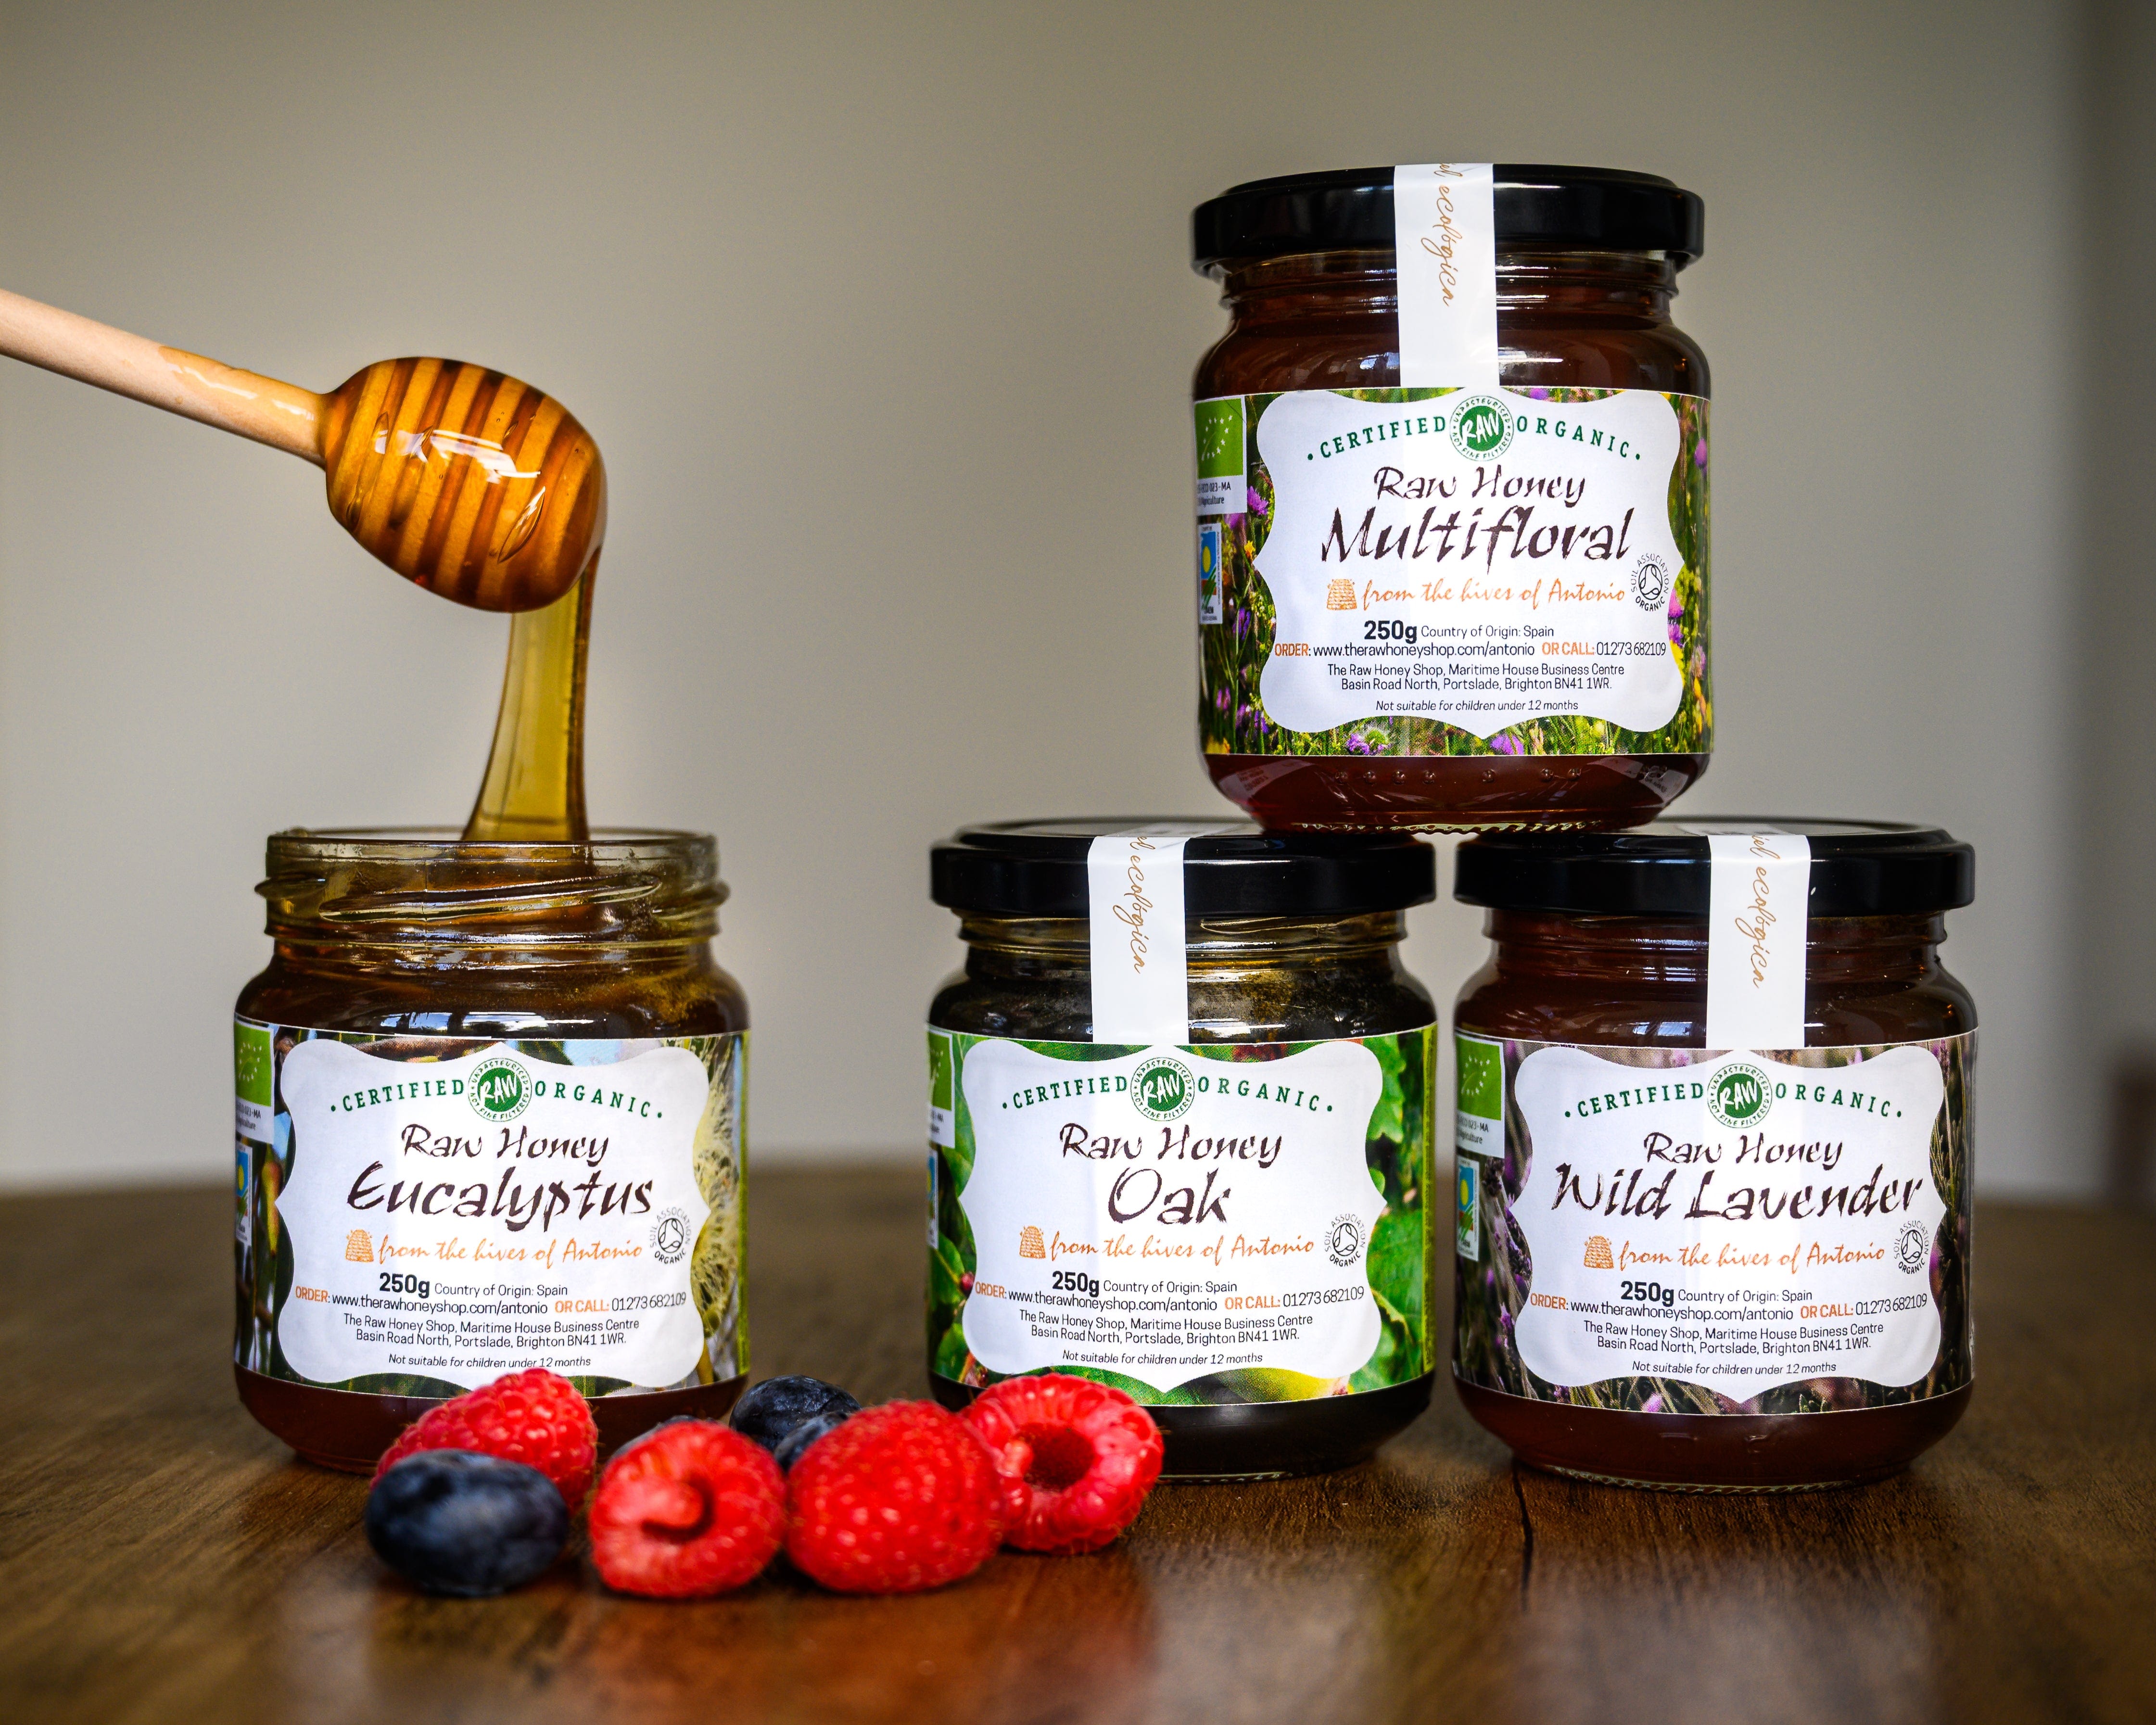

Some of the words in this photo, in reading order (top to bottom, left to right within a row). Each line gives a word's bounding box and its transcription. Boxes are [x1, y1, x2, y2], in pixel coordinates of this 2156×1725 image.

[1320, 416, 1446, 458] CERTIFIED
[1517, 416, 1629, 457] ORGANIC
[1461, 411, 1499, 446] RAW
[1374, 467, 1456, 500] Raw
[1472, 464, 1585, 508] Honey
[1321, 505, 1635, 575] Multifloral
[1637, 553, 1669, 594] ASSOCIATION
[1363, 580, 1415, 611] from
[1422, 578, 1452, 602] the
[1460, 578, 1511, 602] hives
[1520, 579, 1542, 610] of
[1548, 578, 1624, 602] Antonio
[1636, 596, 1665, 612] ORGANIC
[1364, 620, 1417, 644] 250g
[1421, 626, 1466, 640] Country
[1471, 625, 1483, 637] of
[1486, 625, 1520, 639] Origin:
[1524, 625, 1554, 639] Spain
[1275, 643, 1311, 656] ORDER:
[1313, 641, 1535, 659] www.therawhoneyshop.com/antonio
[1328, 663, 1346, 675] The
[1350, 664, 1371, 675] Raw
[1375, 664, 1410, 679] Honey
[1414, 663, 1445, 677] Shop,
[1449, 663, 1499, 675] Maritime
[1503, 663, 1538, 675] House
[1542, 663, 1589, 675] Business
[1592, 663, 1624, 675] Centre
[1342, 678, 1370, 690] Basin
[1373, 678, 1401, 690] Road
[1405, 678, 1440, 691] North,
[1444, 678, 1501, 690] Portslade,
[1505, 677, 1552, 692] Brighton
[1555, 677, 1583, 689] BN41
[1587, 677, 1611, 689] 1WR.
[1376, 700, 1394, 710] Not
[1397, 700, 1436, 710] suitable
[1439, 700, 1453, 710] for
[1456, 700, 1495, 710] children
[1498, 700, 1526, 710] under
[1528, 700, 1541, 710] 12
[1544, 700, 1578, 710] months
[343, 1079, 464, 1112] CERTIFIED
[535, 1080, 650, 1117] ORGANIC
[480, 1073, 517, 1107] RAW
[1013, 1076, 1128, 1108] CERTIFIED
[1198, 1076, 1319, 1111] ORGANIC
[1142, 1073, 1180, 1107] RAW
[1577, 1083, 1703, 1117] CERTIFIED
[1776, 1083, 1890, 1117] ORGANIC
[1719, 1079, 1757, 1114] RAW
[1719, 1114, 1738, 1126] FINE
[401, 1124, 482, 1158] Raw
[497, 1125, 609, 1167] Honey
[1060, 1123, 1141, 1159] Raw
[1158, 1124, 1282, 1168] Honey
[1644, 1132, 1721, 1164] Raw
[1736, 1132, 1842, 1171] Honey
[347, 1161, 653, 1232] Eucalyptus
[1108, 1167, 1231, 1225] Oak
[1551, 1163, 1676, 1220] Wild
[1684, 1164, 1923, 1220] Lavender
[379, 1235, 429, 1264] from
[436, 1237, 466, 1260] the
[473, 1238, 526, 1261] hives
[533, 1239, 556, 1269] of
[563, 1238, 642, 1262] Antonio
[1051, 1231, 1098, 1261] from
[1103, 1234, 1136, 1257] the
[1141, 1235, 1193, 1258] hives
[1202, 1235, 1224, 1266] of
[1231, 1234, 1314, 1259] Antonio
[1900, 1220, 1929, 1255] ASSOCIATION
[1618, 1241, 1673, 1271] from
[1678, 1243, 1709, 1267] the
[1716, 1243, 1770, 1267] hives
[1779, 1243, 1801, 1274] of
[1807, 1242, 1884, 1267] Antonio
[1898, 1258, 1925, 1275] ORGANIC
[296, 1286, 330, 1303] ORDER:
[332, 1294, 547, 1316] www.therawhoneyshop.com/antonio
[380, 1272, 430, 1299] 250g
[435, 1283, 480, 1298] Country
[483, 1284, 495, 1295] of
[498, 1285, 533, 1298] Origin:
[537, 1285, 567, 1298] Spain
[976, 1281, 1006, 1299] ORDER:
[1009, 1291, 1217, 1313] www.therawhoneyshop.com/antonio
[1053, 1271, 1099, 1298] 250g
[1103, 1281, 1149, 1294] Country
[1152, 1281, 1164, 1292] of
[1167, 1281, 1202, 1295] Origin:
[1205, 1281, 1237, 1294] Spain
[1621, 1281, 1674, 1307] 250g
[1678, 1289, 1724, 1304] Country
[1728, 1290, 1739, 1301] of
[1743, 1290, 1778, 1304] Origin:
[1782, 1290, 1812, 1303] Spain
[1531, 1293, 1568, 1310] ORDER:
[1571, 1299, 1793, 1322] www.therawhoneyshop.com/antonio
[1584, 1320, 1602, 1333] The
[1606, 1322, 1628, 1335] Raw
[1632, 1324, 1667, 1340] Honey
[1670, 1327, 1702, 1341] Shop,
[1706, 1328, 1757, 1339] Maritime
[1761, 1328, 1797, 1339] House
[1801, 1327, 1848, 1338] Business
[1851, 1323, 1883, 1335] Centre
[1598, 1335, 1626, 1349] Basin
[1630, 1338, 1658, 1351] Road
[1661, 1340, 1696, 1354] North,
[1700, 1342, 1759, 1355] Portslade,
[1763, 1342, 1810, 1356] Brighton
[1813, 1339, 1842, 1351] BN41
[1845, 1337, 1871, 1349] 1WR.
[1632, 1361, 1650, 1371] Not
[1653, 1363, 1692, 1373] suitable
[1696, 1363, 1710, 1373] for
[1712, 1364, 1752, 1374] children
[1755, 1365, 1783, 1374] under
[1787, 1364, 1799, 1374] 12
[1801, 1362, 1836, 1373] months
